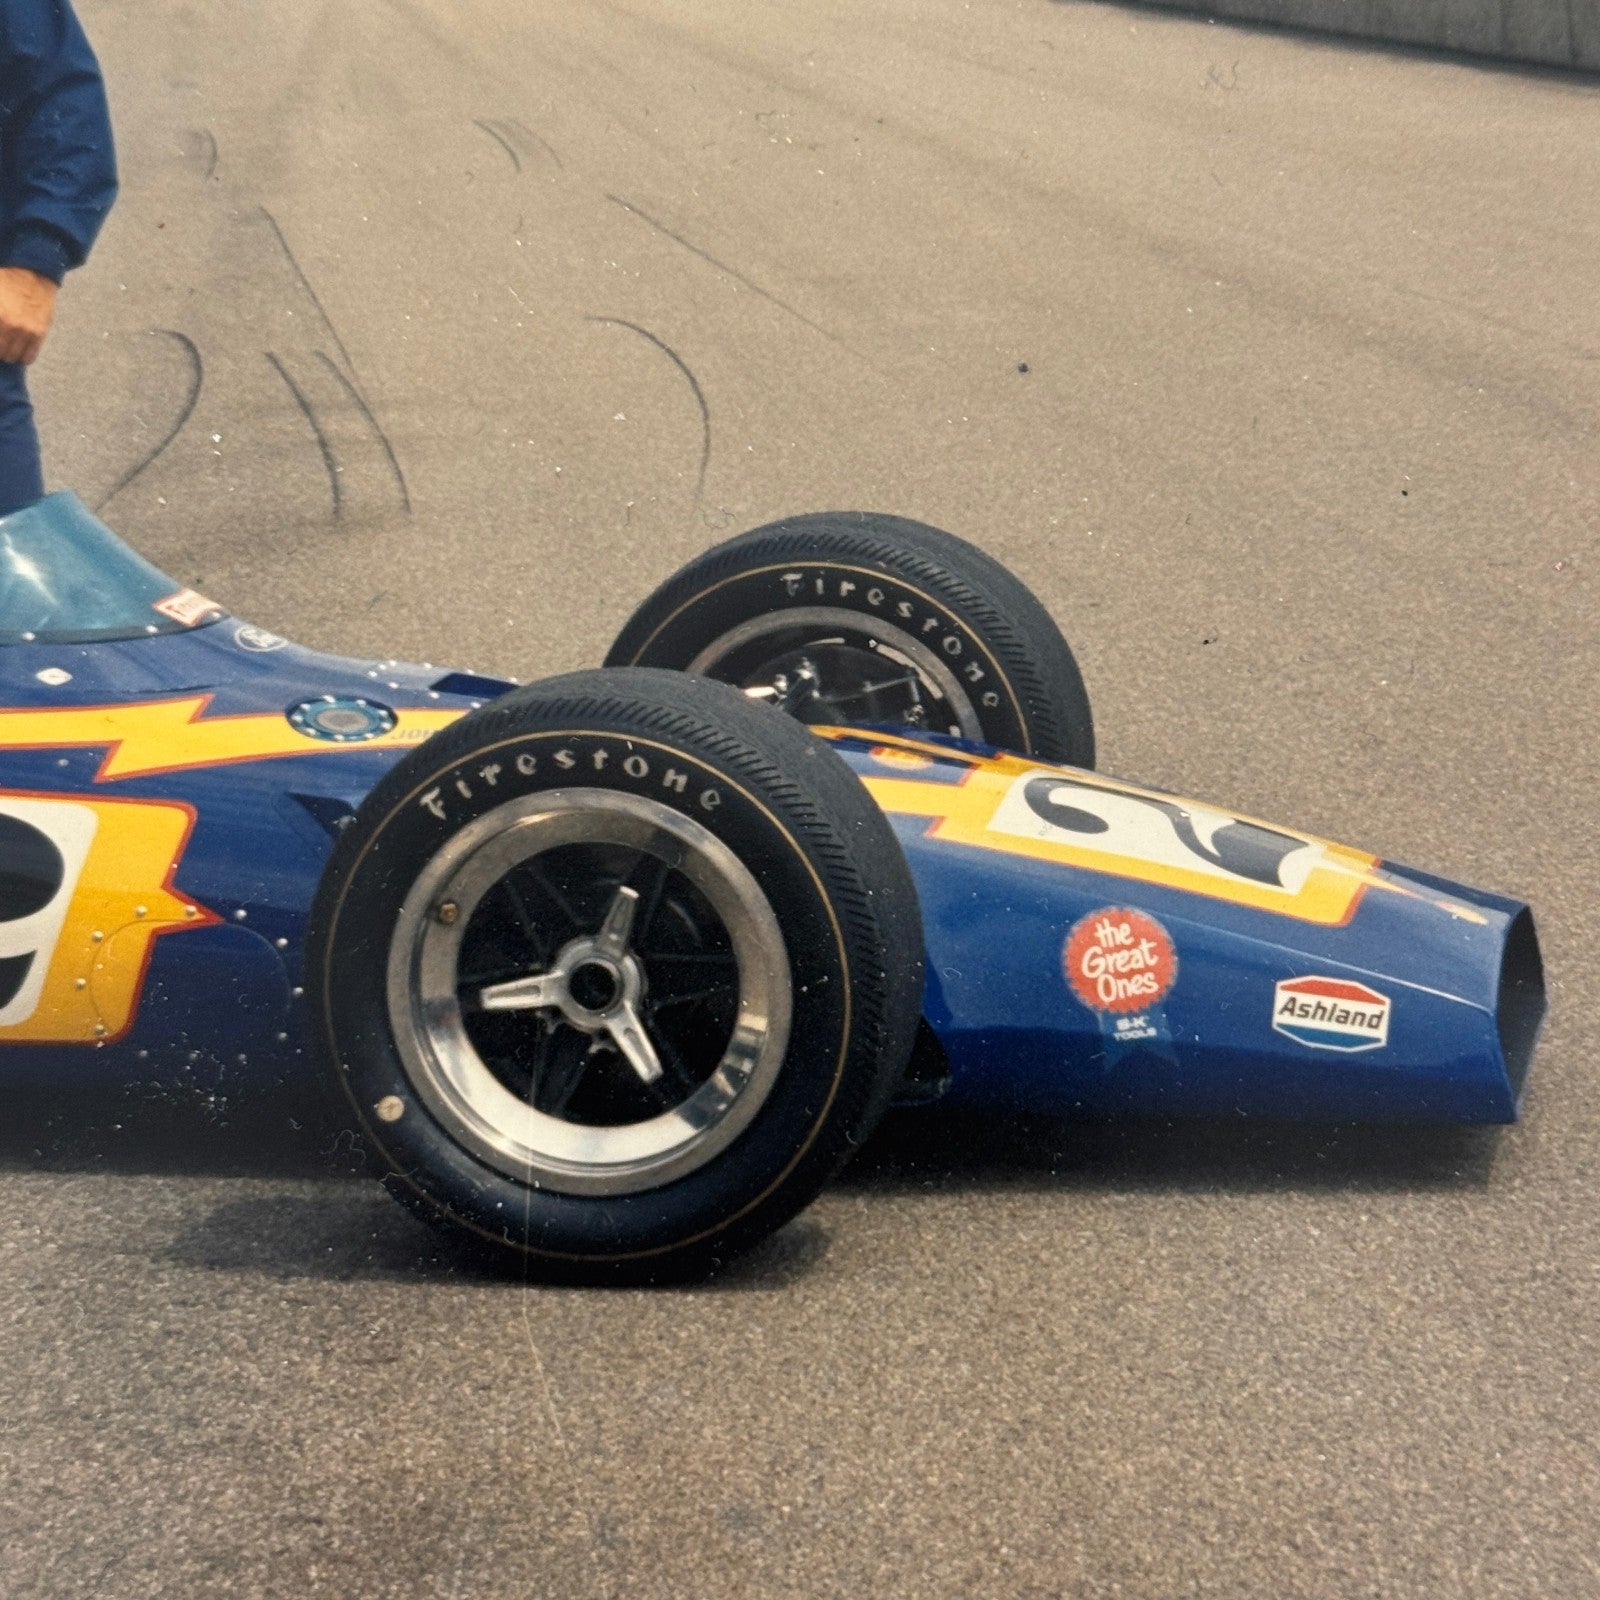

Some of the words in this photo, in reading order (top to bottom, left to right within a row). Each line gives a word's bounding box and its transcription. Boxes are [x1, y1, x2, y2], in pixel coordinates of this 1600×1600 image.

[779, 569, 999, 707] Firestone
[419, 748, 721, 820] Firestone
[1094, 917, 1135, 948] the
[1081, 938, 1159, 979] Great
[1097, 972, 1159, 1003] Ones
[1278, 996, 1385, 1029] Ashland
[1113, 1027, 1157, 1041] TOOLS
